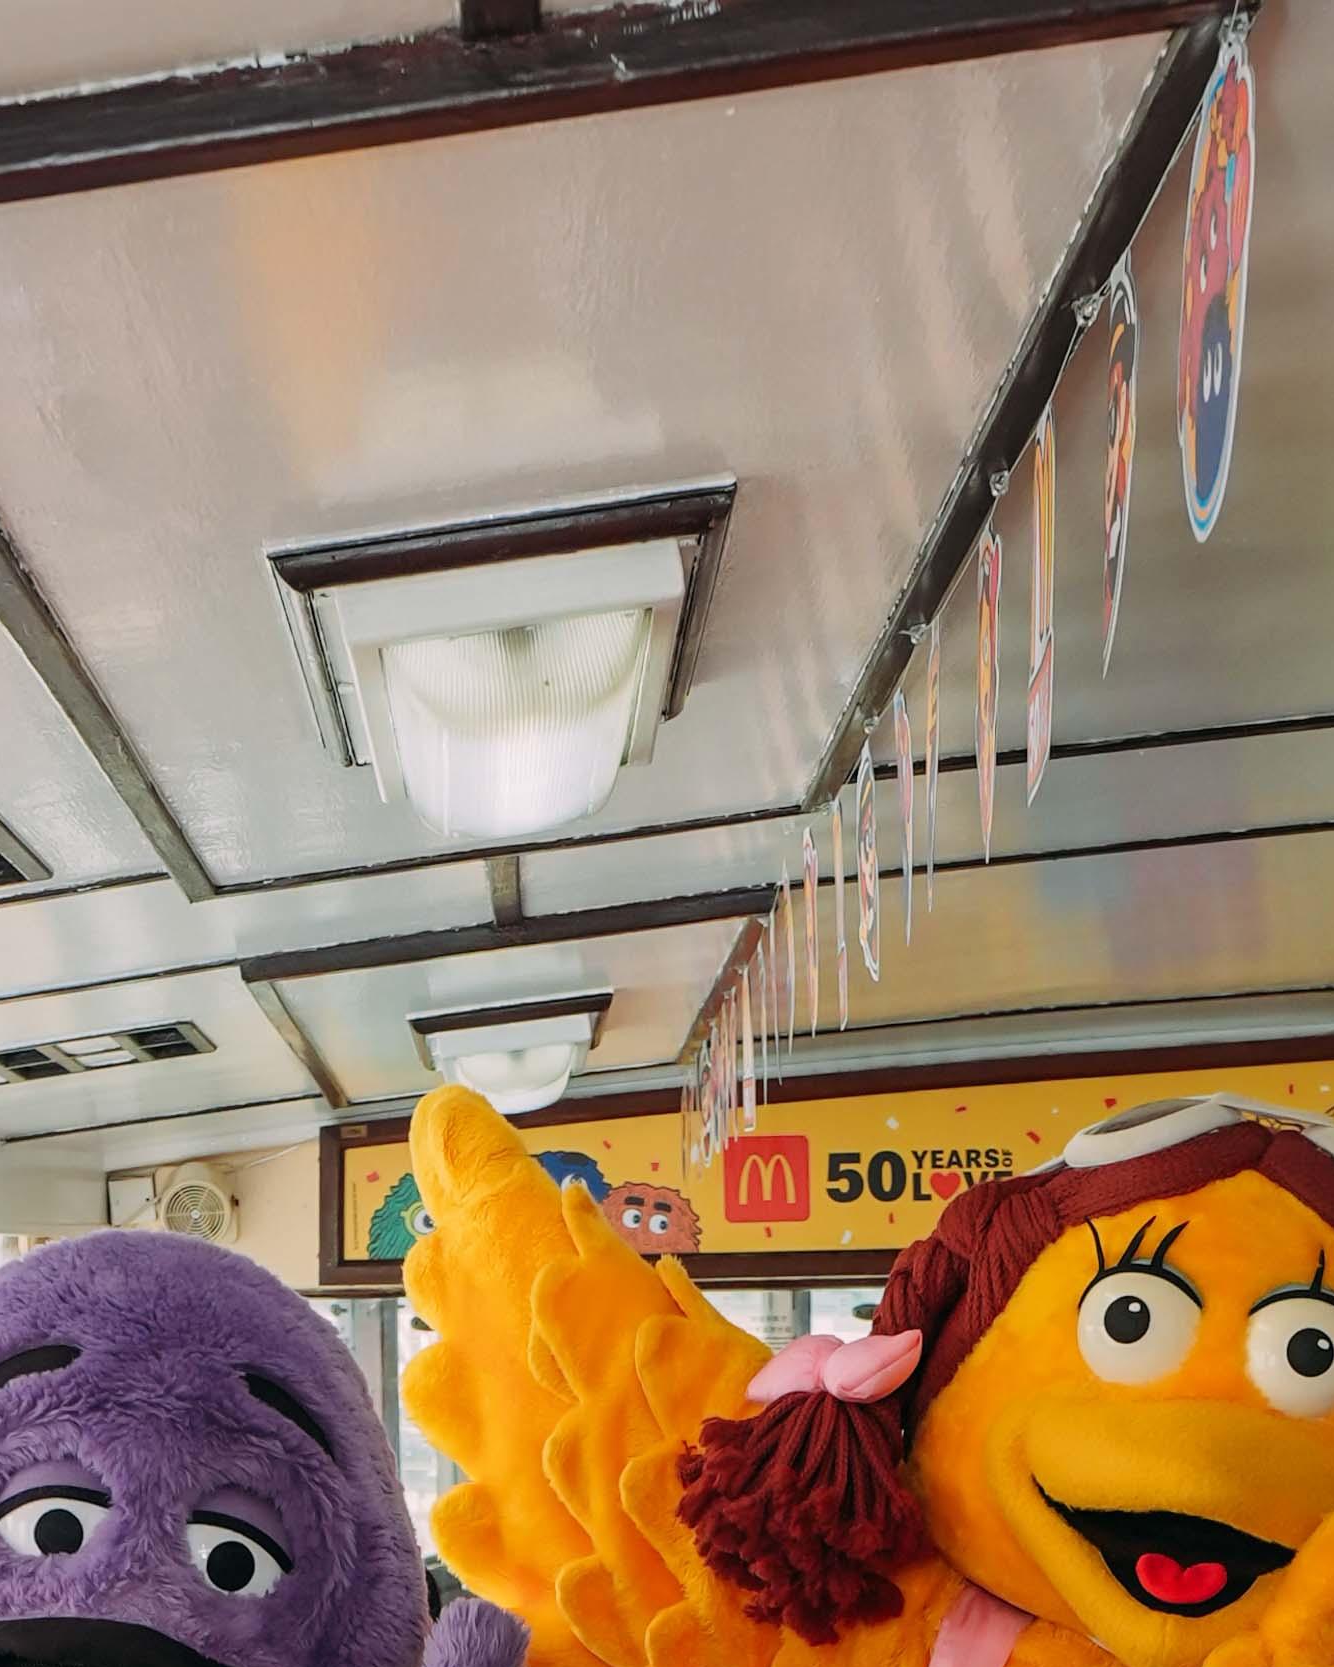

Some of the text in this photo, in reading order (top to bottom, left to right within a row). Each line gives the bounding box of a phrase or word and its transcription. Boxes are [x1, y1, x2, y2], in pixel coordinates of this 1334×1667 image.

[826, 1148, 1013, 1203] 50 YEARS OF
